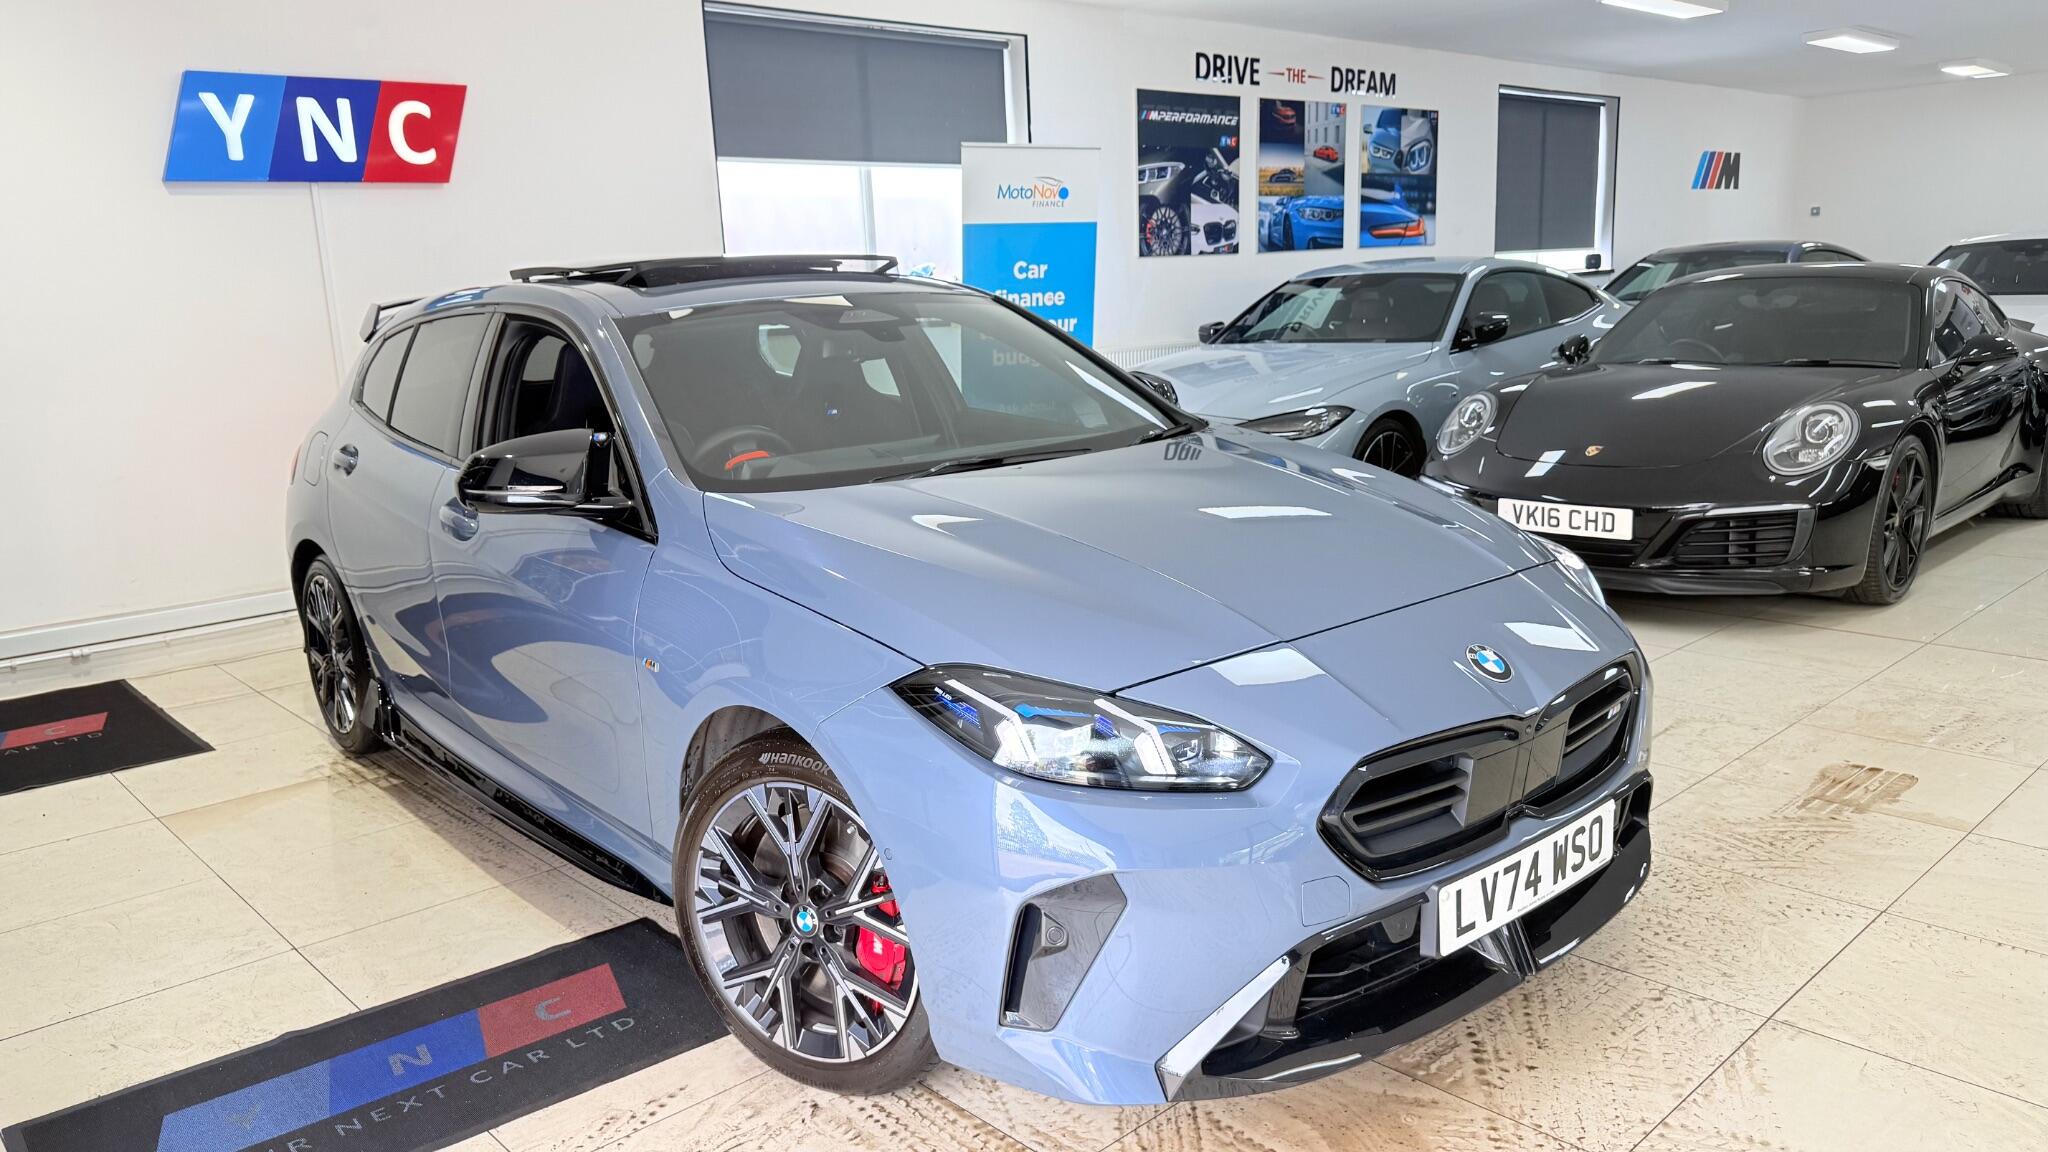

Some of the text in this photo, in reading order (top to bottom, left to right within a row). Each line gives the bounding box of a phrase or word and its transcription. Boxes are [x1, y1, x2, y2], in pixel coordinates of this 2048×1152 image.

[1195, 51, 1396, 97] DRIVE THE DREAM
[198, 91, 437, 165] YNC
[997, 183, 1070, 200] MotoNovo
[1032, 200, 1065, 208] FINANCE
[1013, 260, 1049, 280] Car
[1512, 503, 1615, 533] VK16 CHD
[1455, 814, 1603, 938] LV74 WSO
[334, 1017, 636, 1137] NEXT CAR LTD
